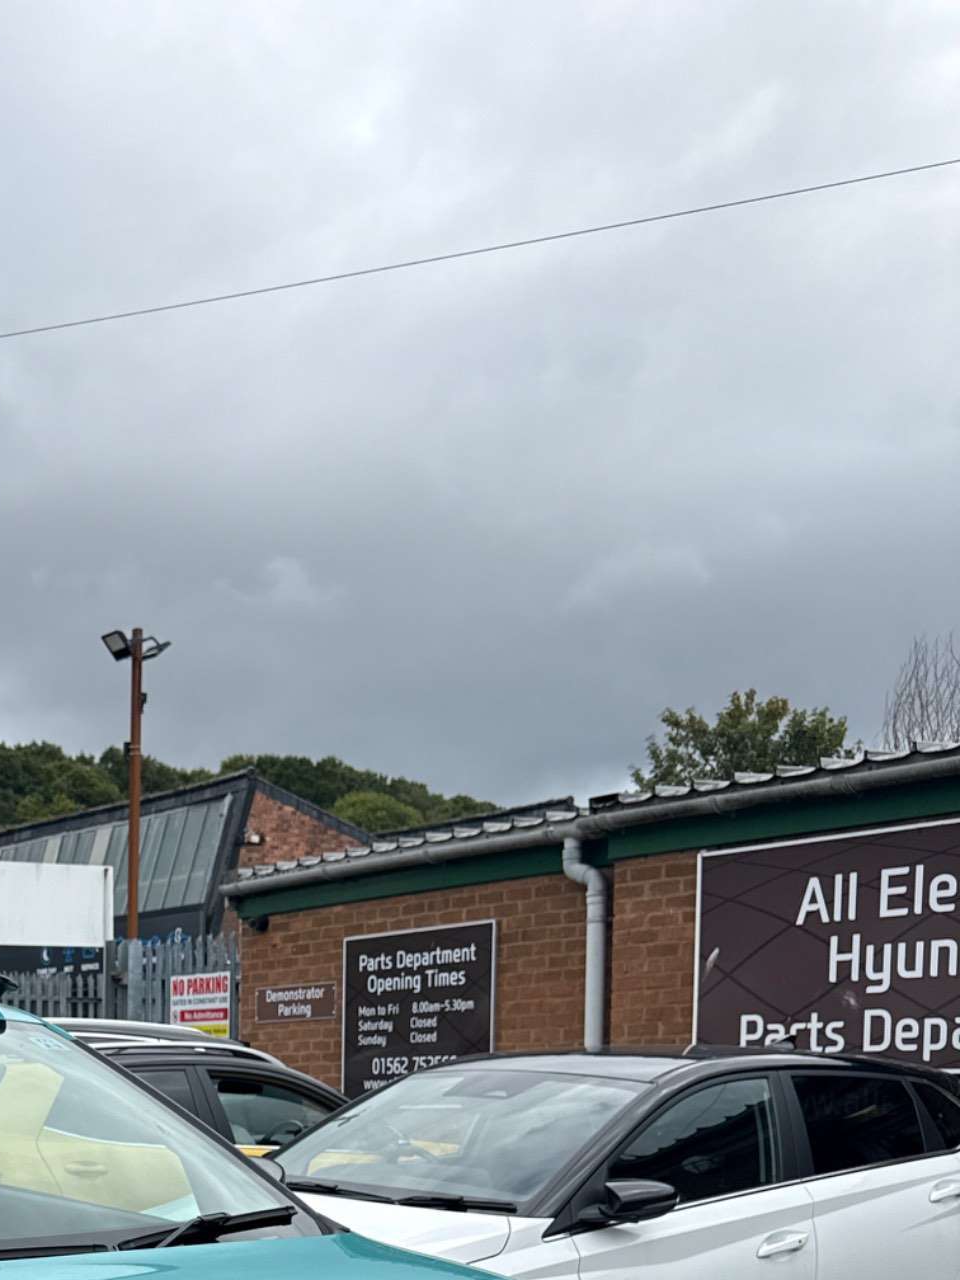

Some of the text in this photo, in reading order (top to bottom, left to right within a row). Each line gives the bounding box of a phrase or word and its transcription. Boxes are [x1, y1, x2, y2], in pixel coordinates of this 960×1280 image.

[796, 872, 858, 926] All
[358, 942, 477, 972] Parts Department
[829, 933, 958, 993] Hyun
[172, 975, 228, 996] NO PARKING
[367, 968, 466, 996] Opening Times
[266, 986, 325, 1003] Demonstrator
[193, 1010, 224, 1020] Admittance
[278, 1002, 312, 1018] Parking
[358, 1005, 376, 1017] Mon
[377, 1004, 386, 1016] to
[387, 1003, 400, 1015] Fri
[358, 1016, 438, 1032] Saturday Closed
[358, 1031, 438, 1047] Sunday Closed
[371, 1056, 408, 1075] 01562
